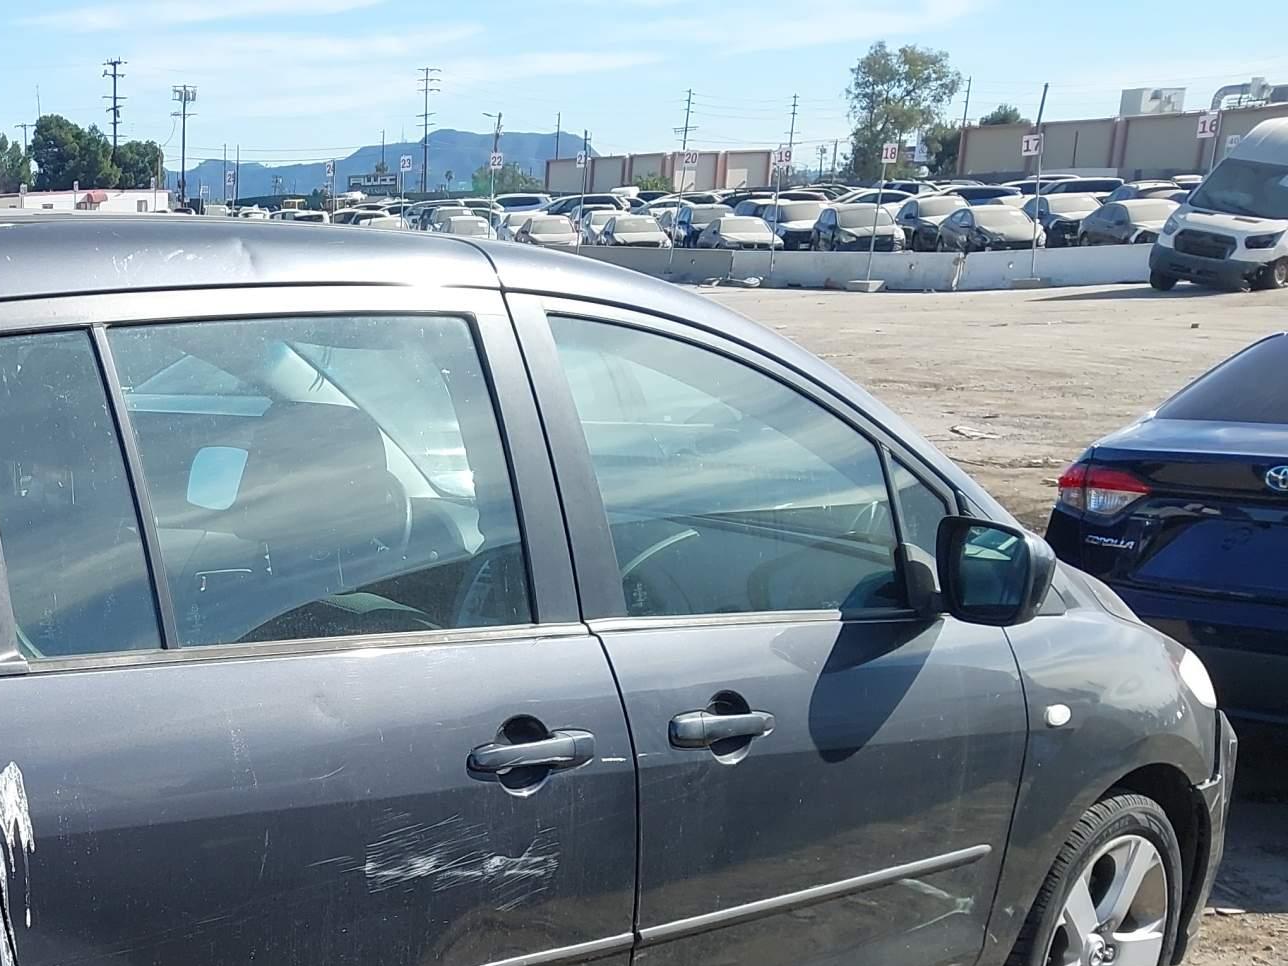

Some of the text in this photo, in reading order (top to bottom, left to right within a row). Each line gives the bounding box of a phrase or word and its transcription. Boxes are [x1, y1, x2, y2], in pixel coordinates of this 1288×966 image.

[1023, 138, 1040, 152] 17
[684, 152, 697, 164] 20
[777, 150, 792, 162] 19
[883, 147, 896, 160] 18
[401, 158, 411, 168] 23
[491, 156, 502, 166] 22
